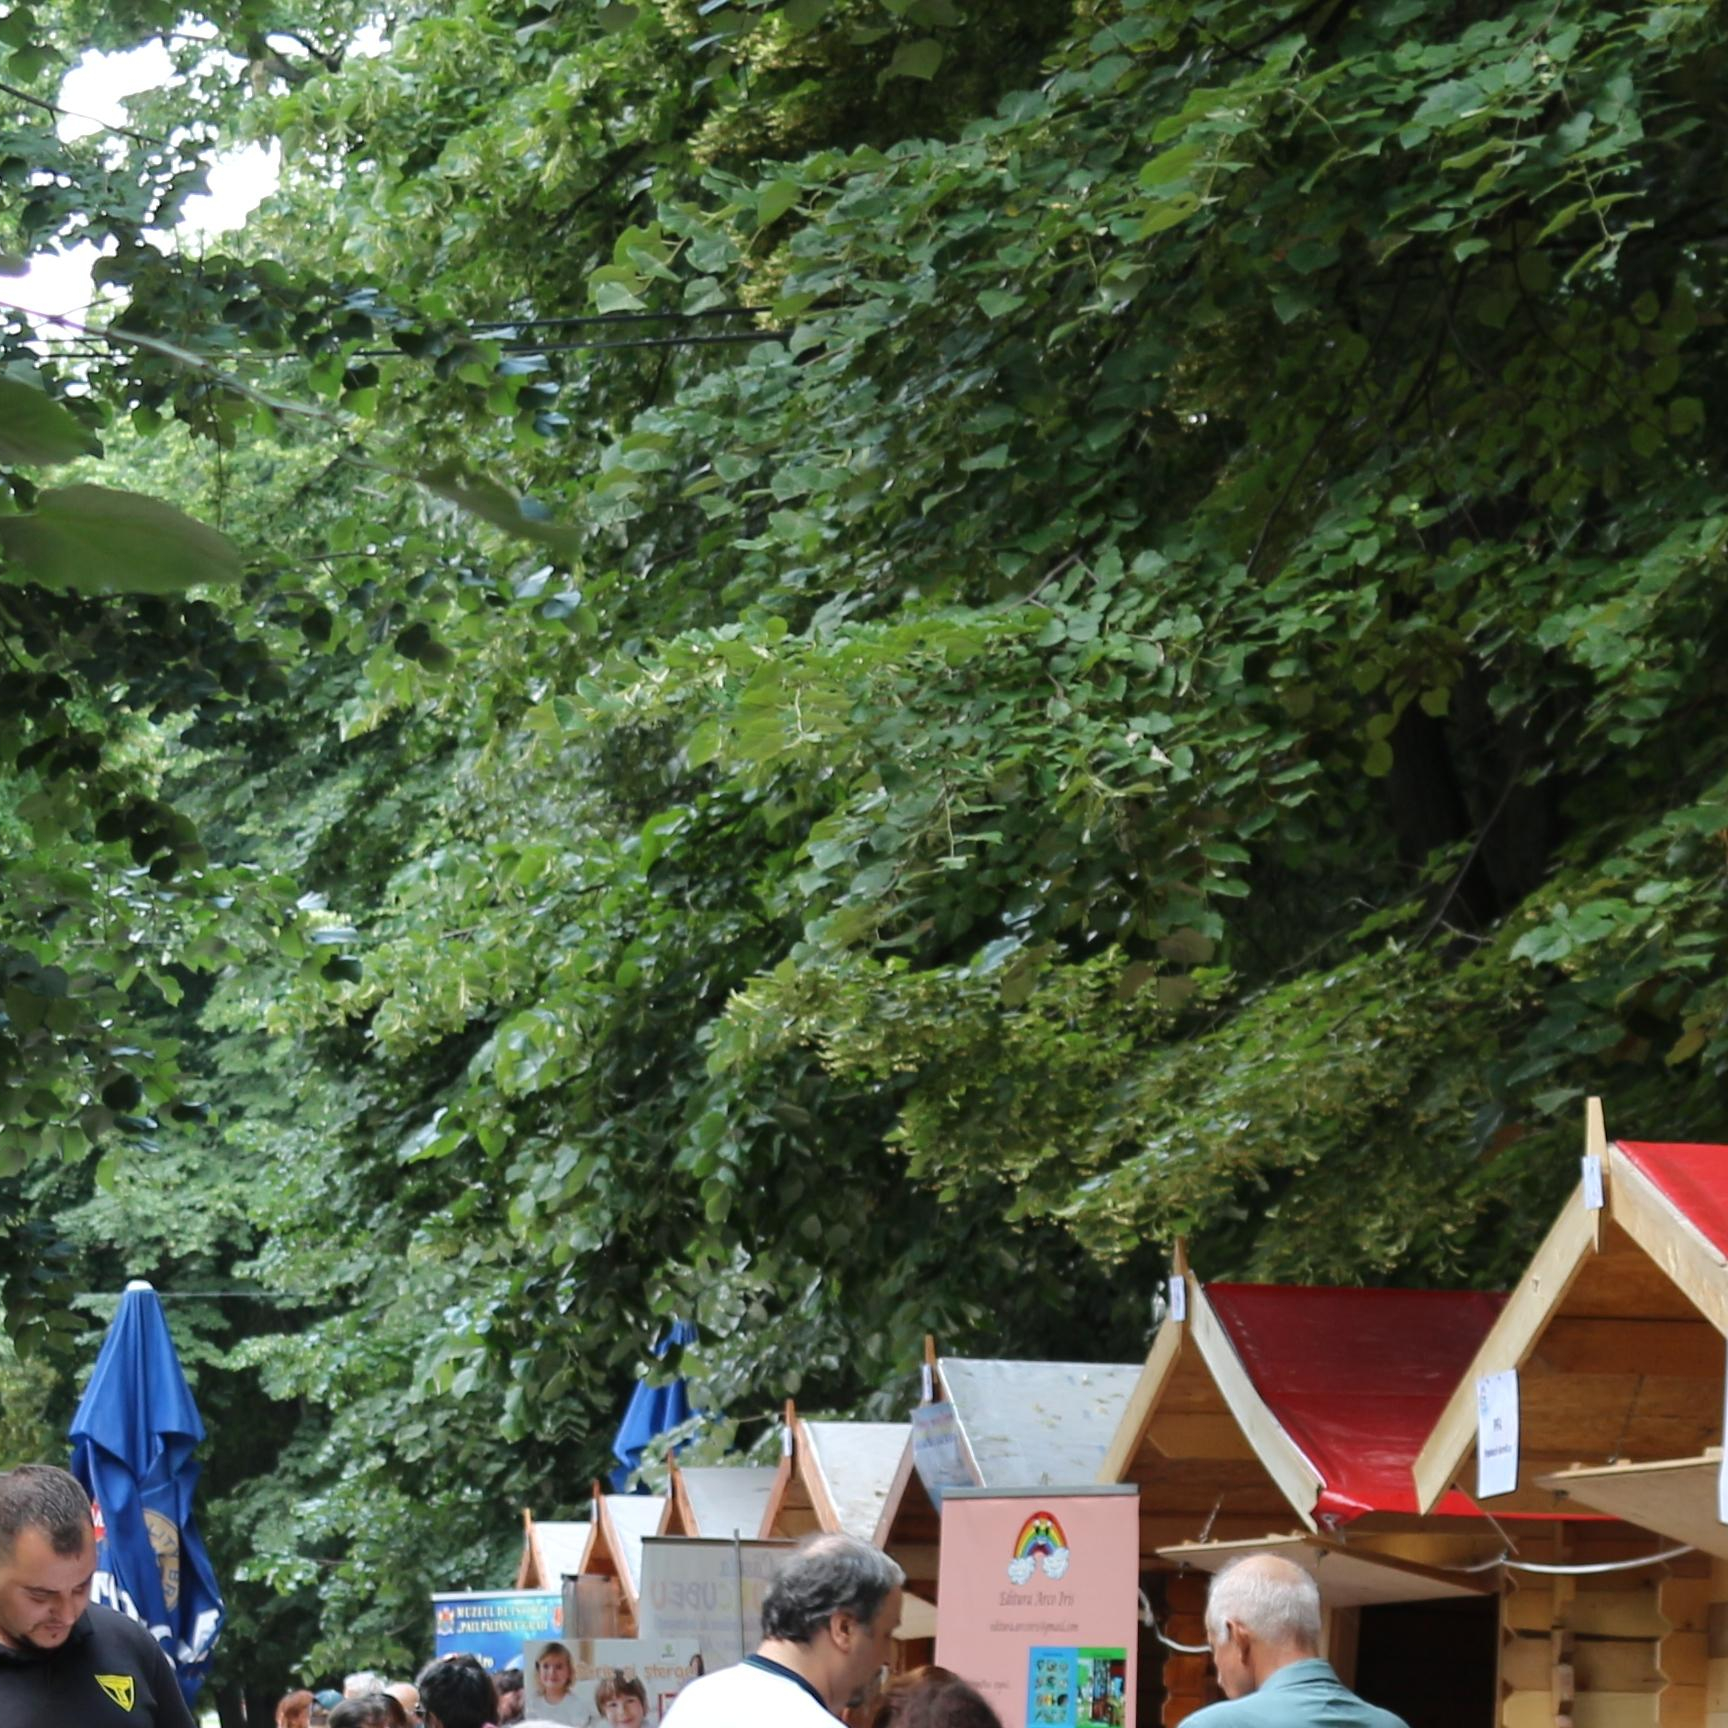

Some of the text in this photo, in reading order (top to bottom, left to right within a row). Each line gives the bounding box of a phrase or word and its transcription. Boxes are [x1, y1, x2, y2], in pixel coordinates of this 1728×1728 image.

[999, 1591, 1074, 1607] Editura Arco Iris
[456, 1606, 495, 1618] MUZEUL
[497, 1606, 509, 1617] DE
